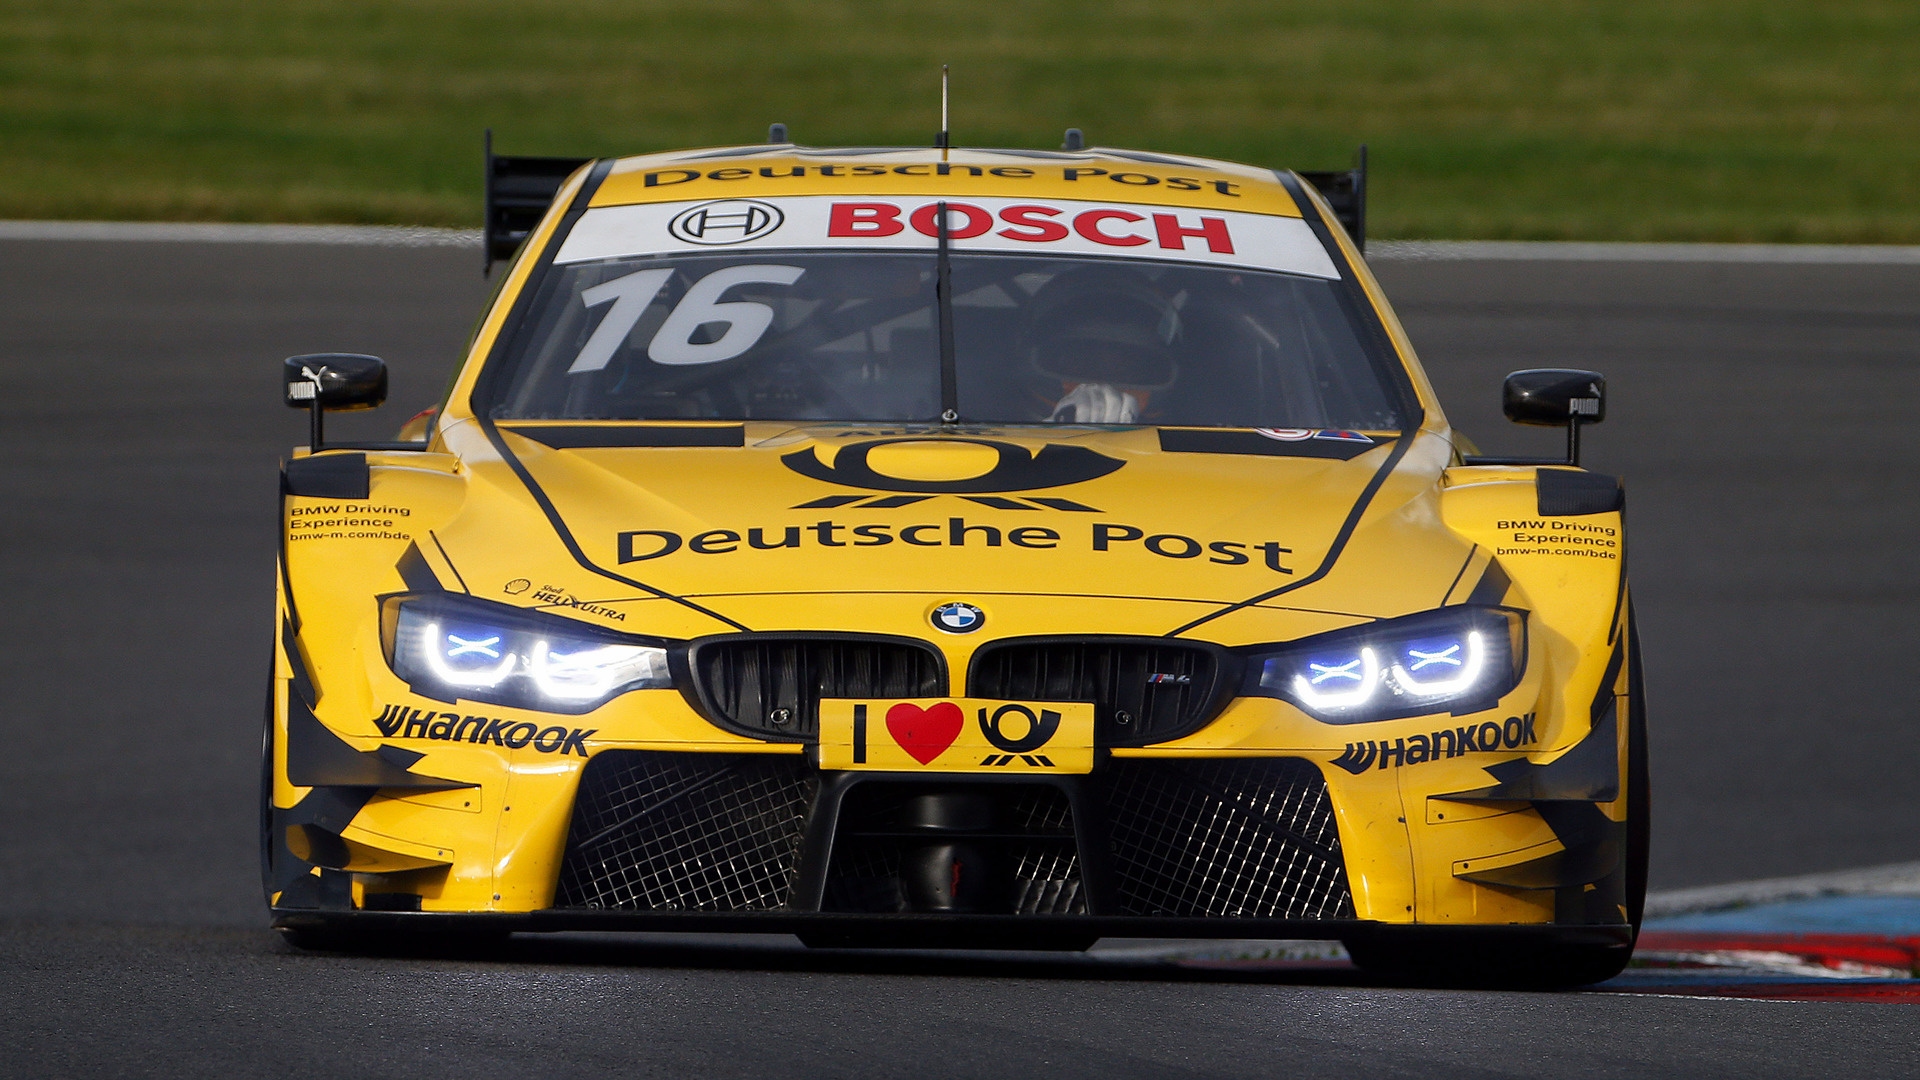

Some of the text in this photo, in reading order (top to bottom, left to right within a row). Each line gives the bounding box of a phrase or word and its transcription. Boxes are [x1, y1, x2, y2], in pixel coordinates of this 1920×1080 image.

[644, 162, 1240, 197] Deutsche Post
[828, 202, 1236, 255] BOSCH
[567, 264, 806, 374] 16
[291, 504, 411, 517] BMW Driving
[290, 517, 393, 529] Experience
[1497, 521, 1616, 537] BMW Driving
[290, 531, 410, 541] bmw-m.com/bde
[1514, 533, 1616, 548] Experience
[617, 517, 1293, 575] Deutsche Post
[1497, 547, 1617, 559] bmw-m.com/bde
[579, 602, 626, 621] ULTRA
[853, 704, 867, 764] I
